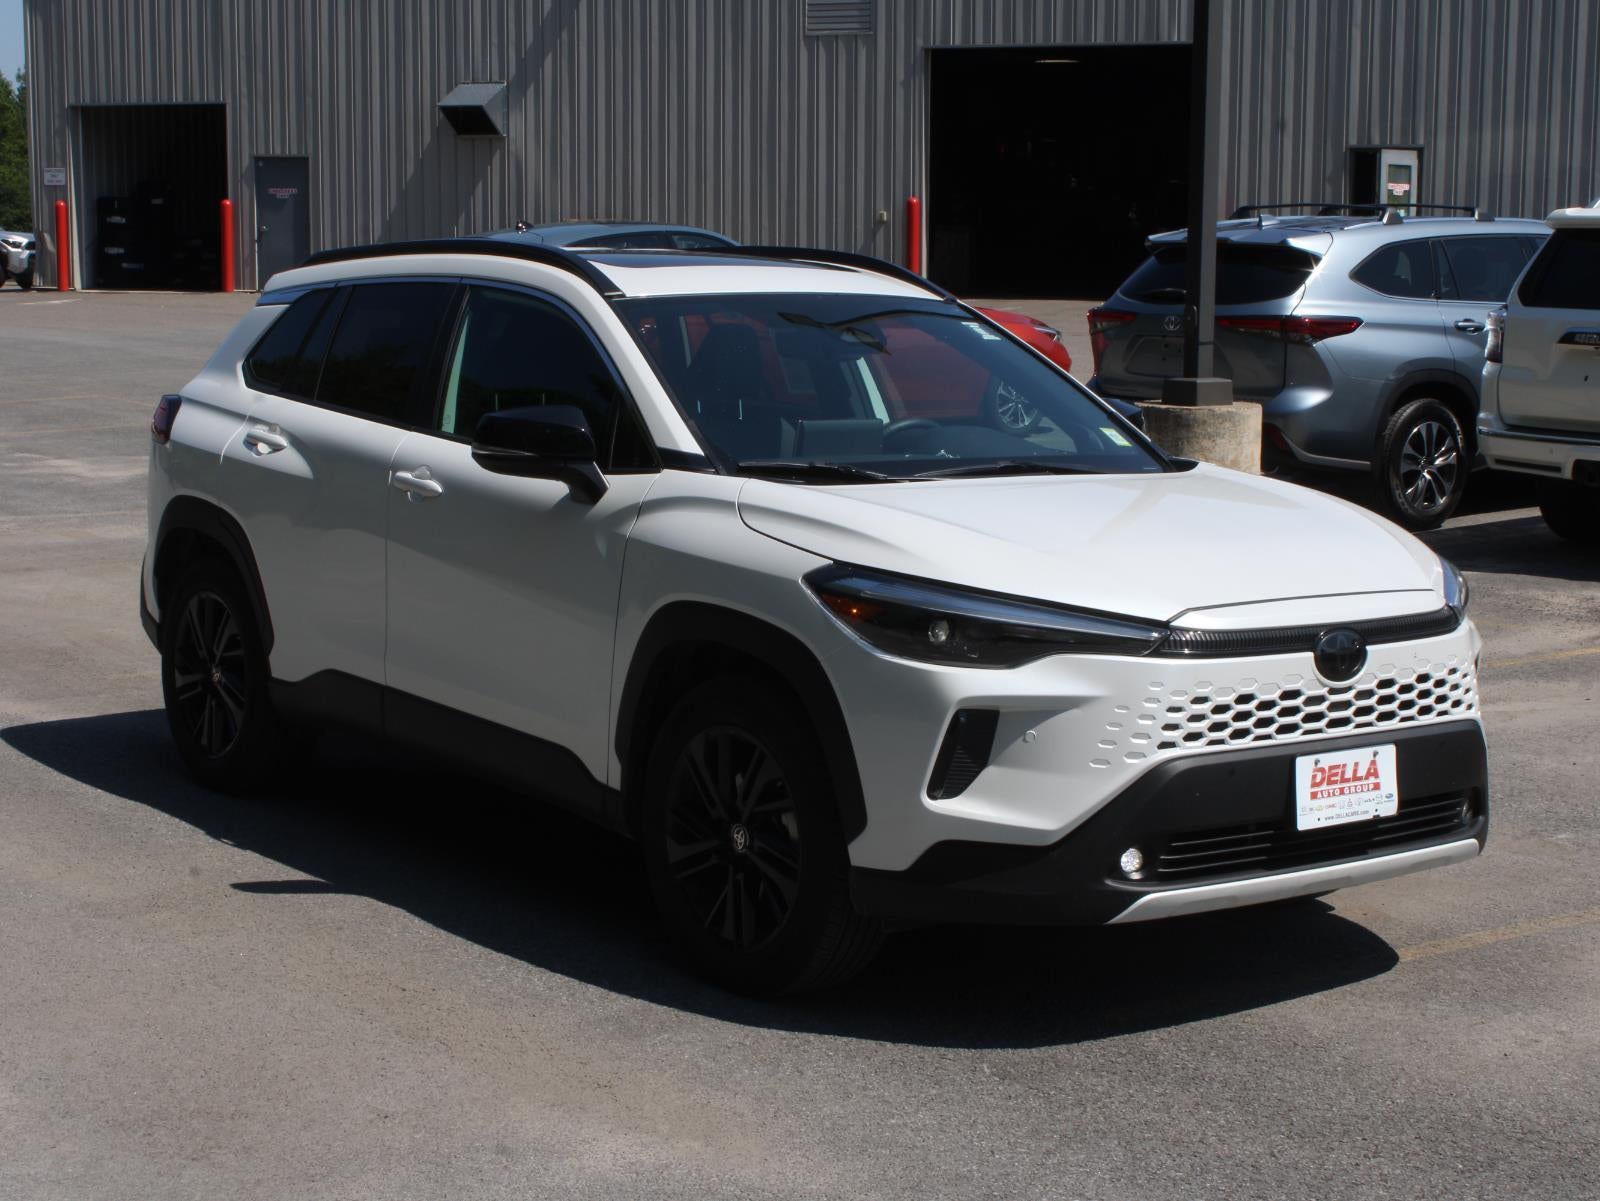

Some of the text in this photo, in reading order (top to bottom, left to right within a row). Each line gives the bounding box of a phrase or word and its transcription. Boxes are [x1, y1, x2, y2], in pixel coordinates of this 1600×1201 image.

[1311, 760, 1379, 788] DELLA
[1317, 783, 1375, 799] AUTO GROUP
